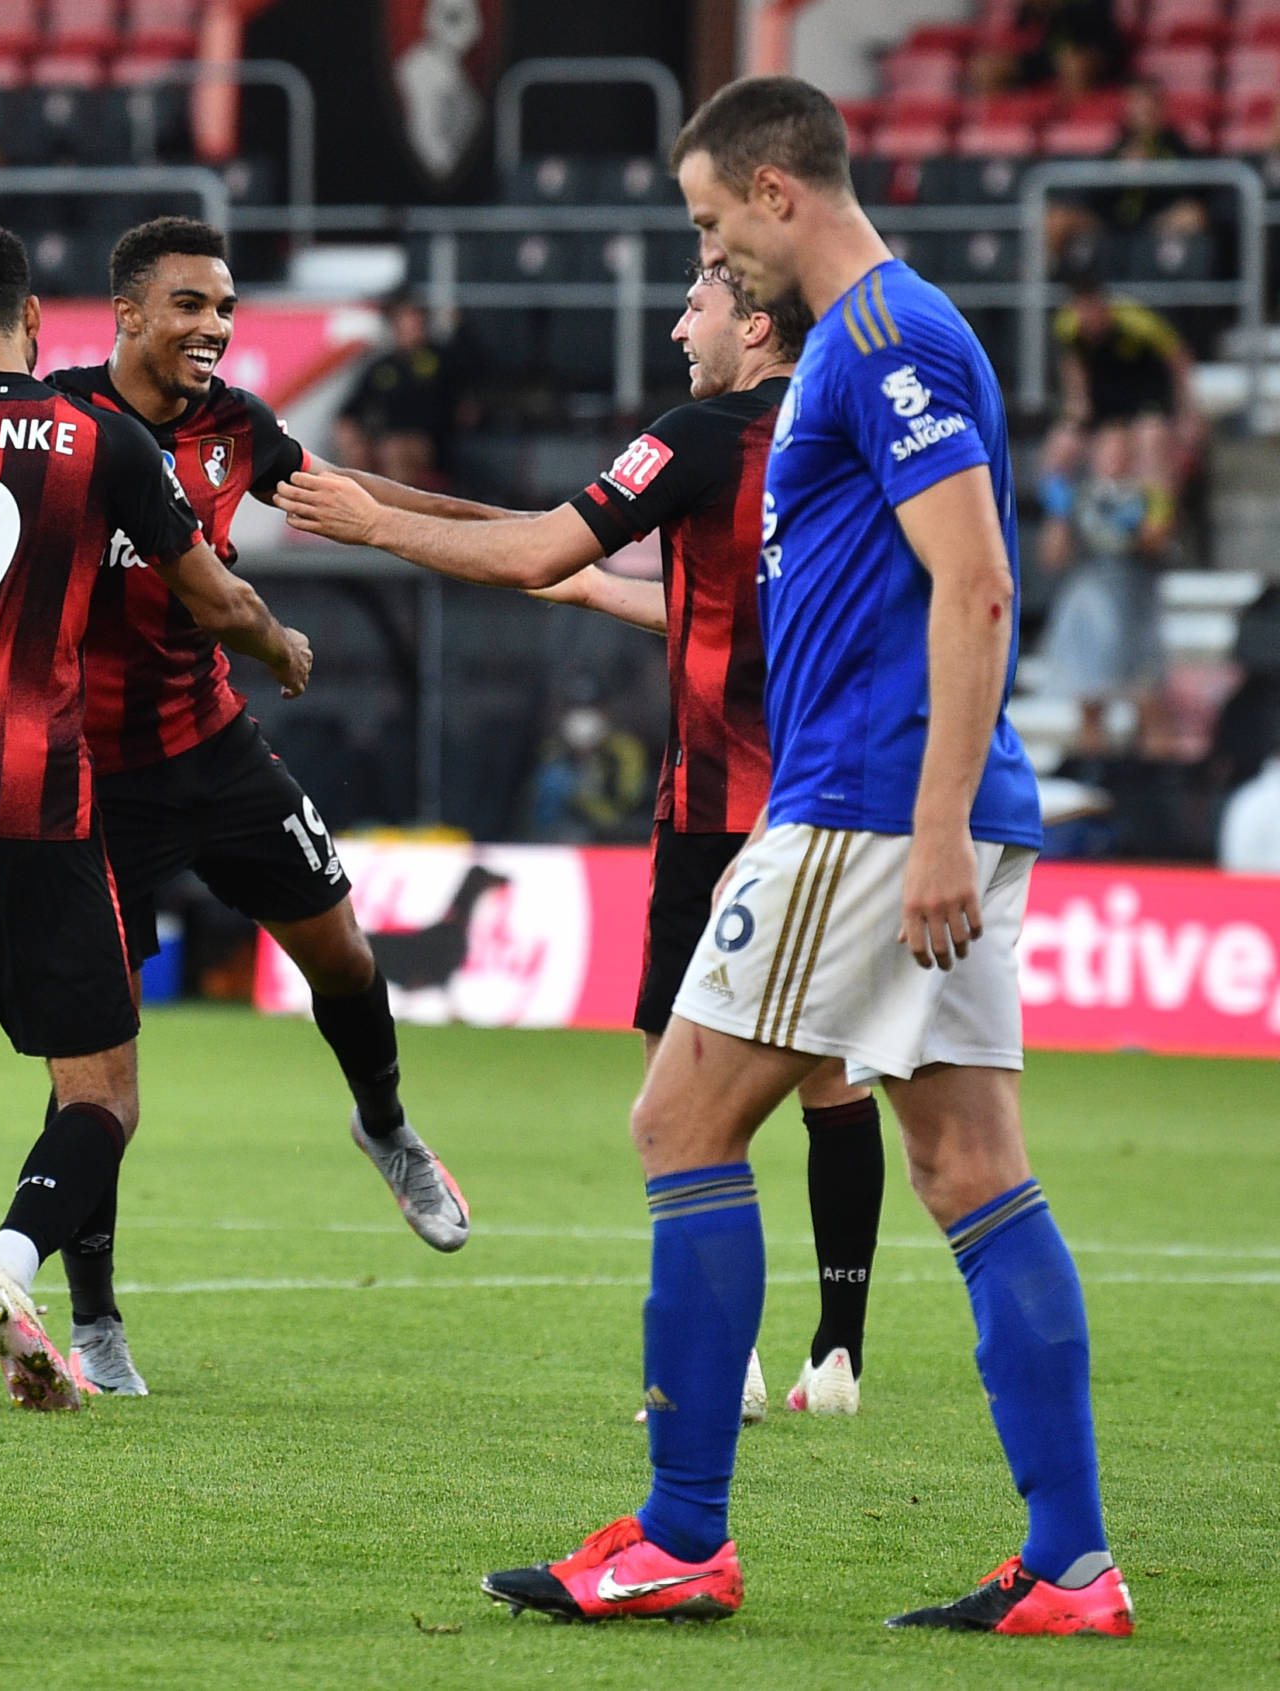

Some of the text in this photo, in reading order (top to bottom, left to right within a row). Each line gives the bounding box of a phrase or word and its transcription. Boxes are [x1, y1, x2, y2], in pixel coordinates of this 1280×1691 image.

[890, 414, 967, 461] SAIGON
[100, 528, 149, 568] ta
[282, 794, 335, 872] 19
[714, 878, 760, 953] 6
[823, 1267, 867, 1283] AFCB
